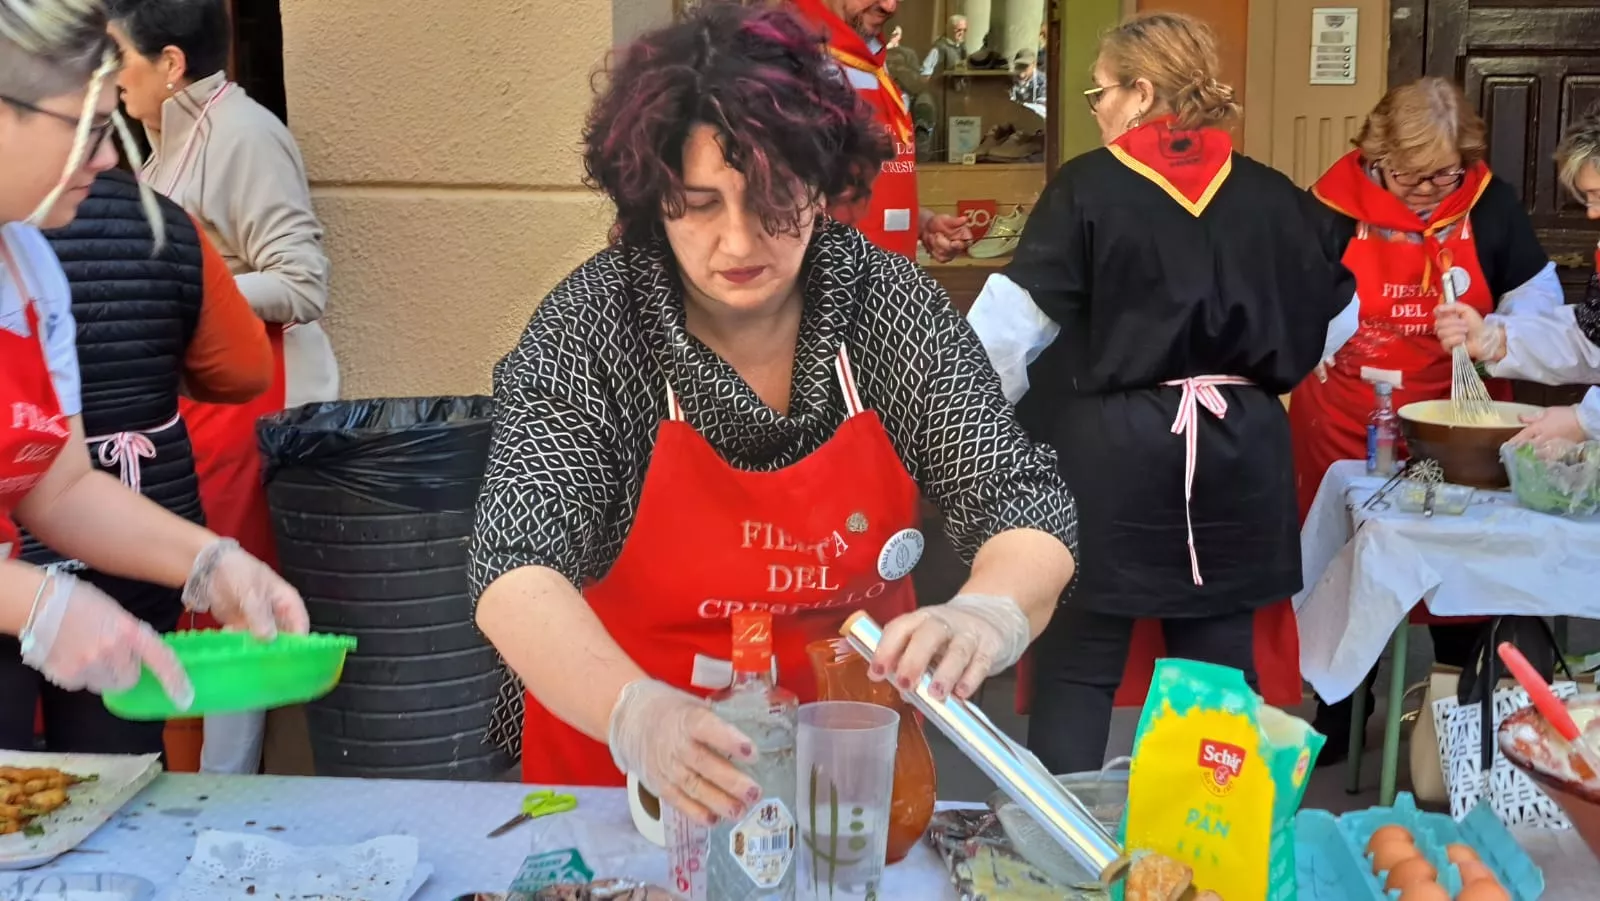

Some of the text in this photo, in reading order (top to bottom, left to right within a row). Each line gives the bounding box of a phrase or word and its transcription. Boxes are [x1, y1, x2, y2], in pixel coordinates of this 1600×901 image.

[1391, 303, 1428, 318] DEL
[766, 564, 840, 593] DEL
[1203, 744, 1242, 774] Schär
[1184, 807, 1231, 839] PAN
